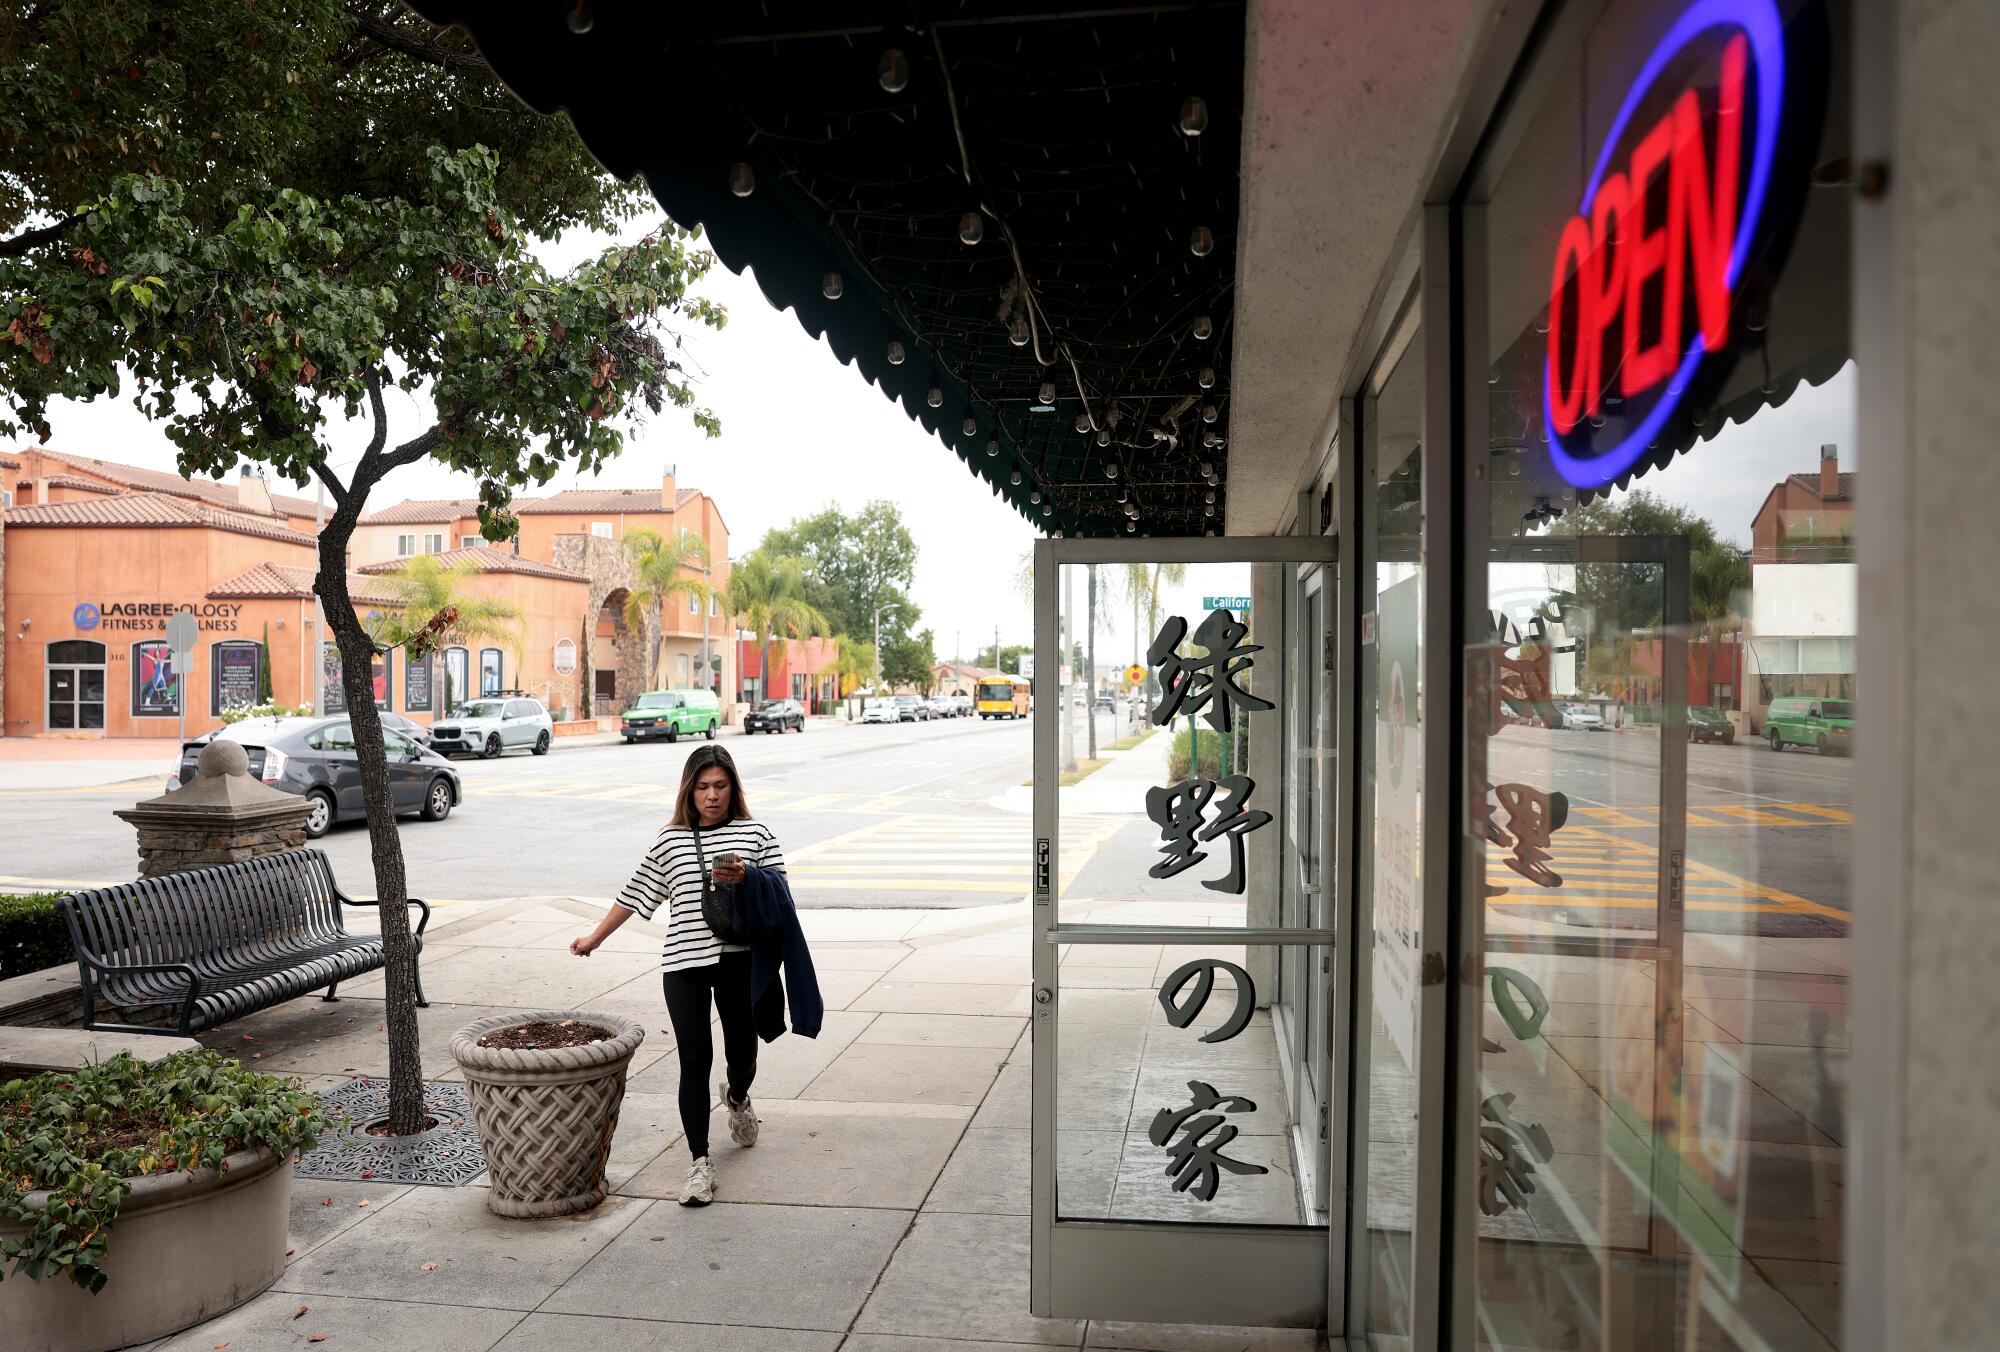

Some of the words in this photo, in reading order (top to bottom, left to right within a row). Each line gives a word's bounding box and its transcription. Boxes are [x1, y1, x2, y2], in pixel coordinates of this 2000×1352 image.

[1547, 31, 1747, 436] OPEN
[1212, 597, 1251, 608] Califor
[102, 619, 154, 631] FITNESS
[158, 619, 167, 631] &
[198, 620, 237, 632] LNESS
[1038, 843, 1049, 888] PULL
